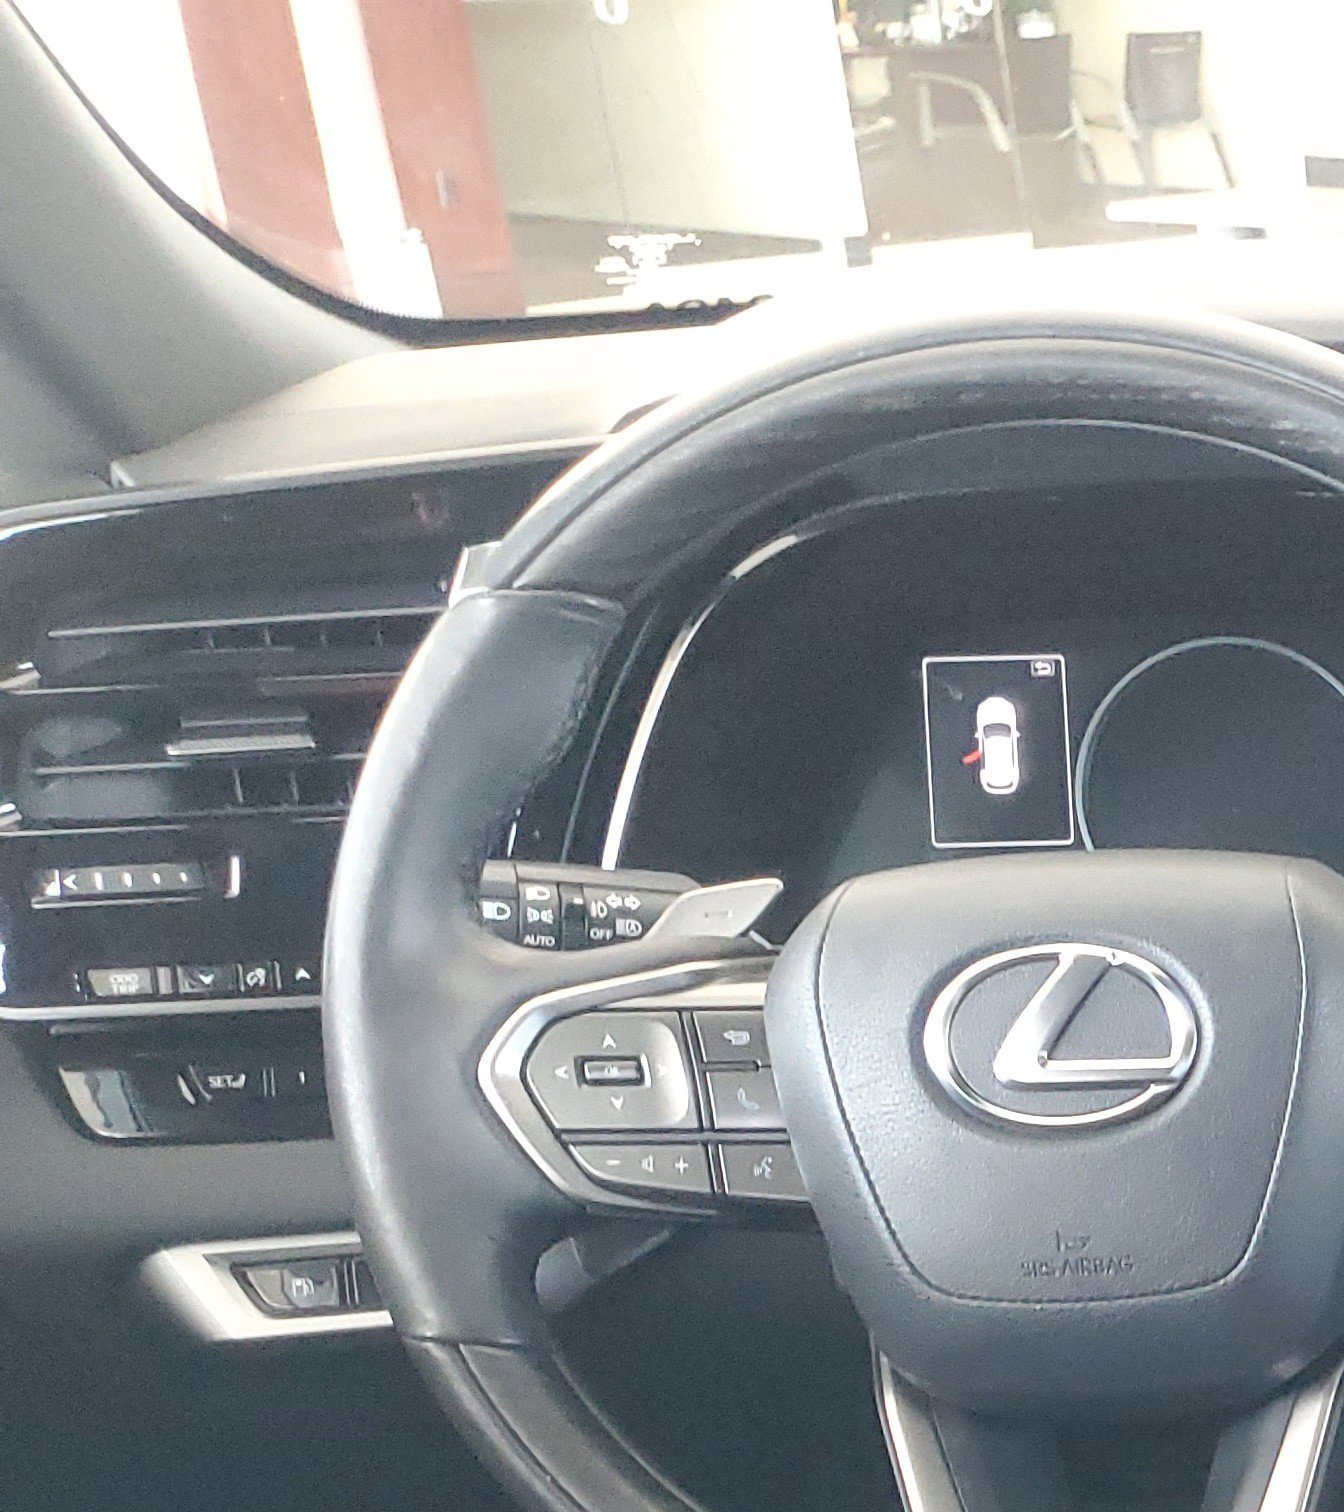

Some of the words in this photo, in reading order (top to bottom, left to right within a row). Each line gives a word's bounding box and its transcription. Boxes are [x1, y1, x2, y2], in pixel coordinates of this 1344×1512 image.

[523, 933, 556, 948] AUTO
[589, 927, 614, 941] OFF
[1061, 1254, 1135, 1277] AIRBAG
